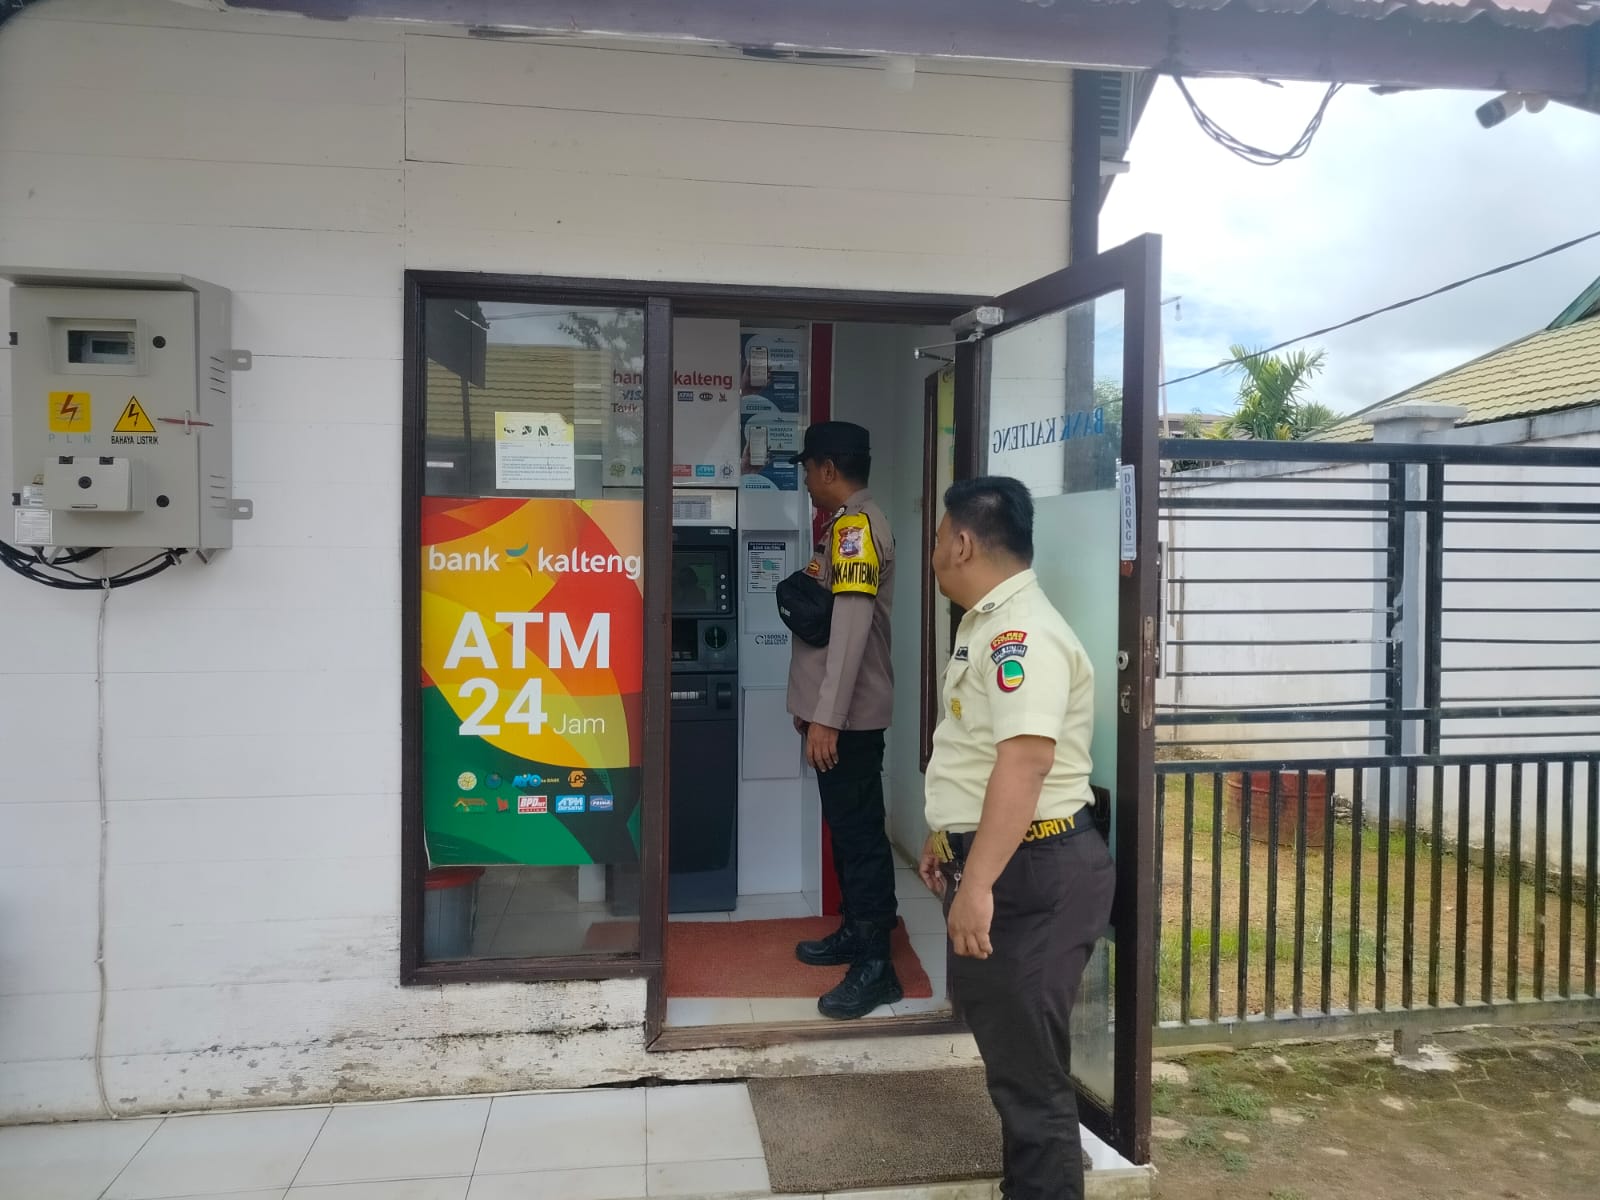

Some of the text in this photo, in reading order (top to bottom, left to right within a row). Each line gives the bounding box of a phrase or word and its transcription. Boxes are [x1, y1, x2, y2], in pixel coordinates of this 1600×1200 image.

[613, 370, 643, 384] ban
[674, 370, 733, 389] kalteng
[622, 390, 643, 400] VIS
[111, 436, 159, 445] BAHAYA LISTRIK
[1124, 473, 1133, 541] DORONG
[428, 545, 641, 580] bank kalteng
[832, 562, 878, 587] NKAMTIBMAS
[443, 611, 611, 670] ATM
[458, 678, 605, 736] 24 Jam
[569, 774, 587, 784] LPS
[1022, 815, 1076, 843] CURITY
